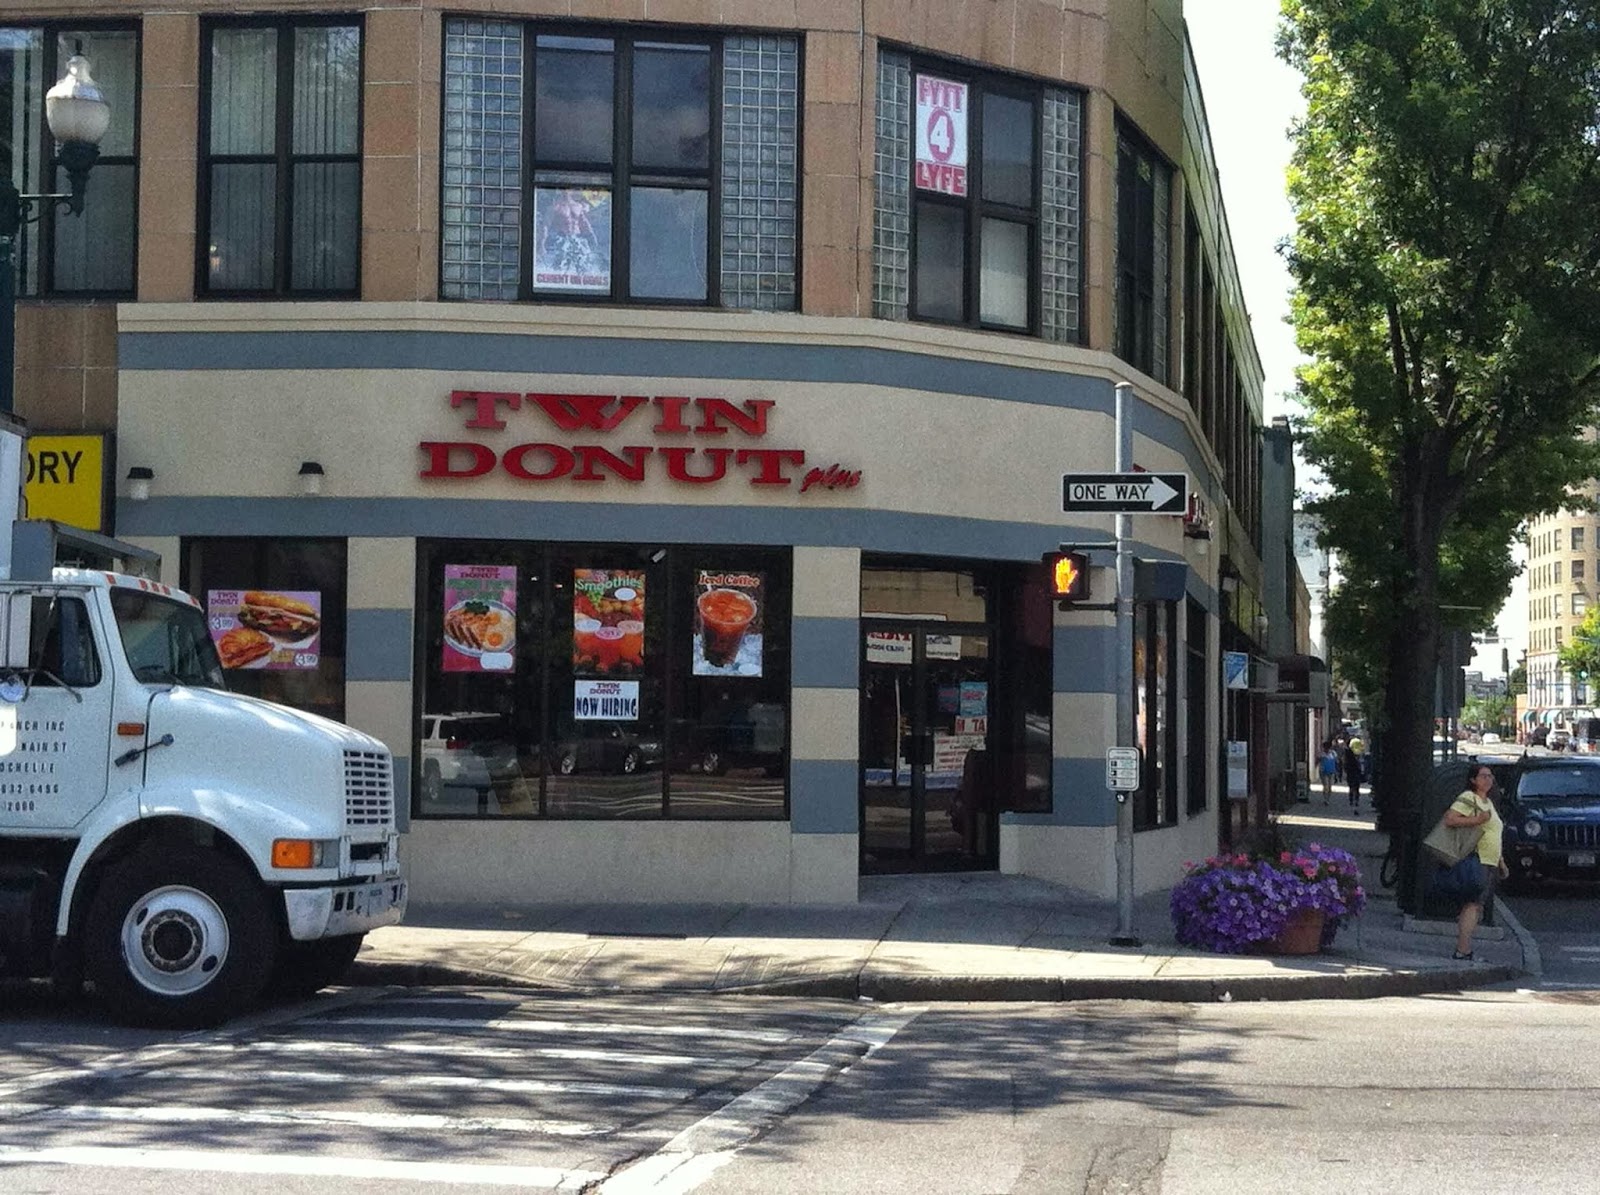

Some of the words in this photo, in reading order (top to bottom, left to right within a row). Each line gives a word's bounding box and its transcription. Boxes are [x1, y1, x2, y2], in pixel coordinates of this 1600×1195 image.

[929, 115, 951, 154] 4
[917, 161, 966, 195] LYFE
[450, 390, 777, 437] TWIN
[419, 441, 806, 487] DONUT
[799, 463, 864, 493] plus
[1074, 485, 1107, 500] ONE
[1115, 485, 1150, 500] WAY
[576, 575, 643, 593] Smoothies
[699, 573, 722, 586] Iced
[725, 574, 760, 588] Coffee
[576, 697, 599, 716] NOW
[601, 697, 637, 717] HIRING
[46, 721, 65, 732] INC
[21, 742, 48, 752] MAIN
[53, 742, 67, 753] ST
